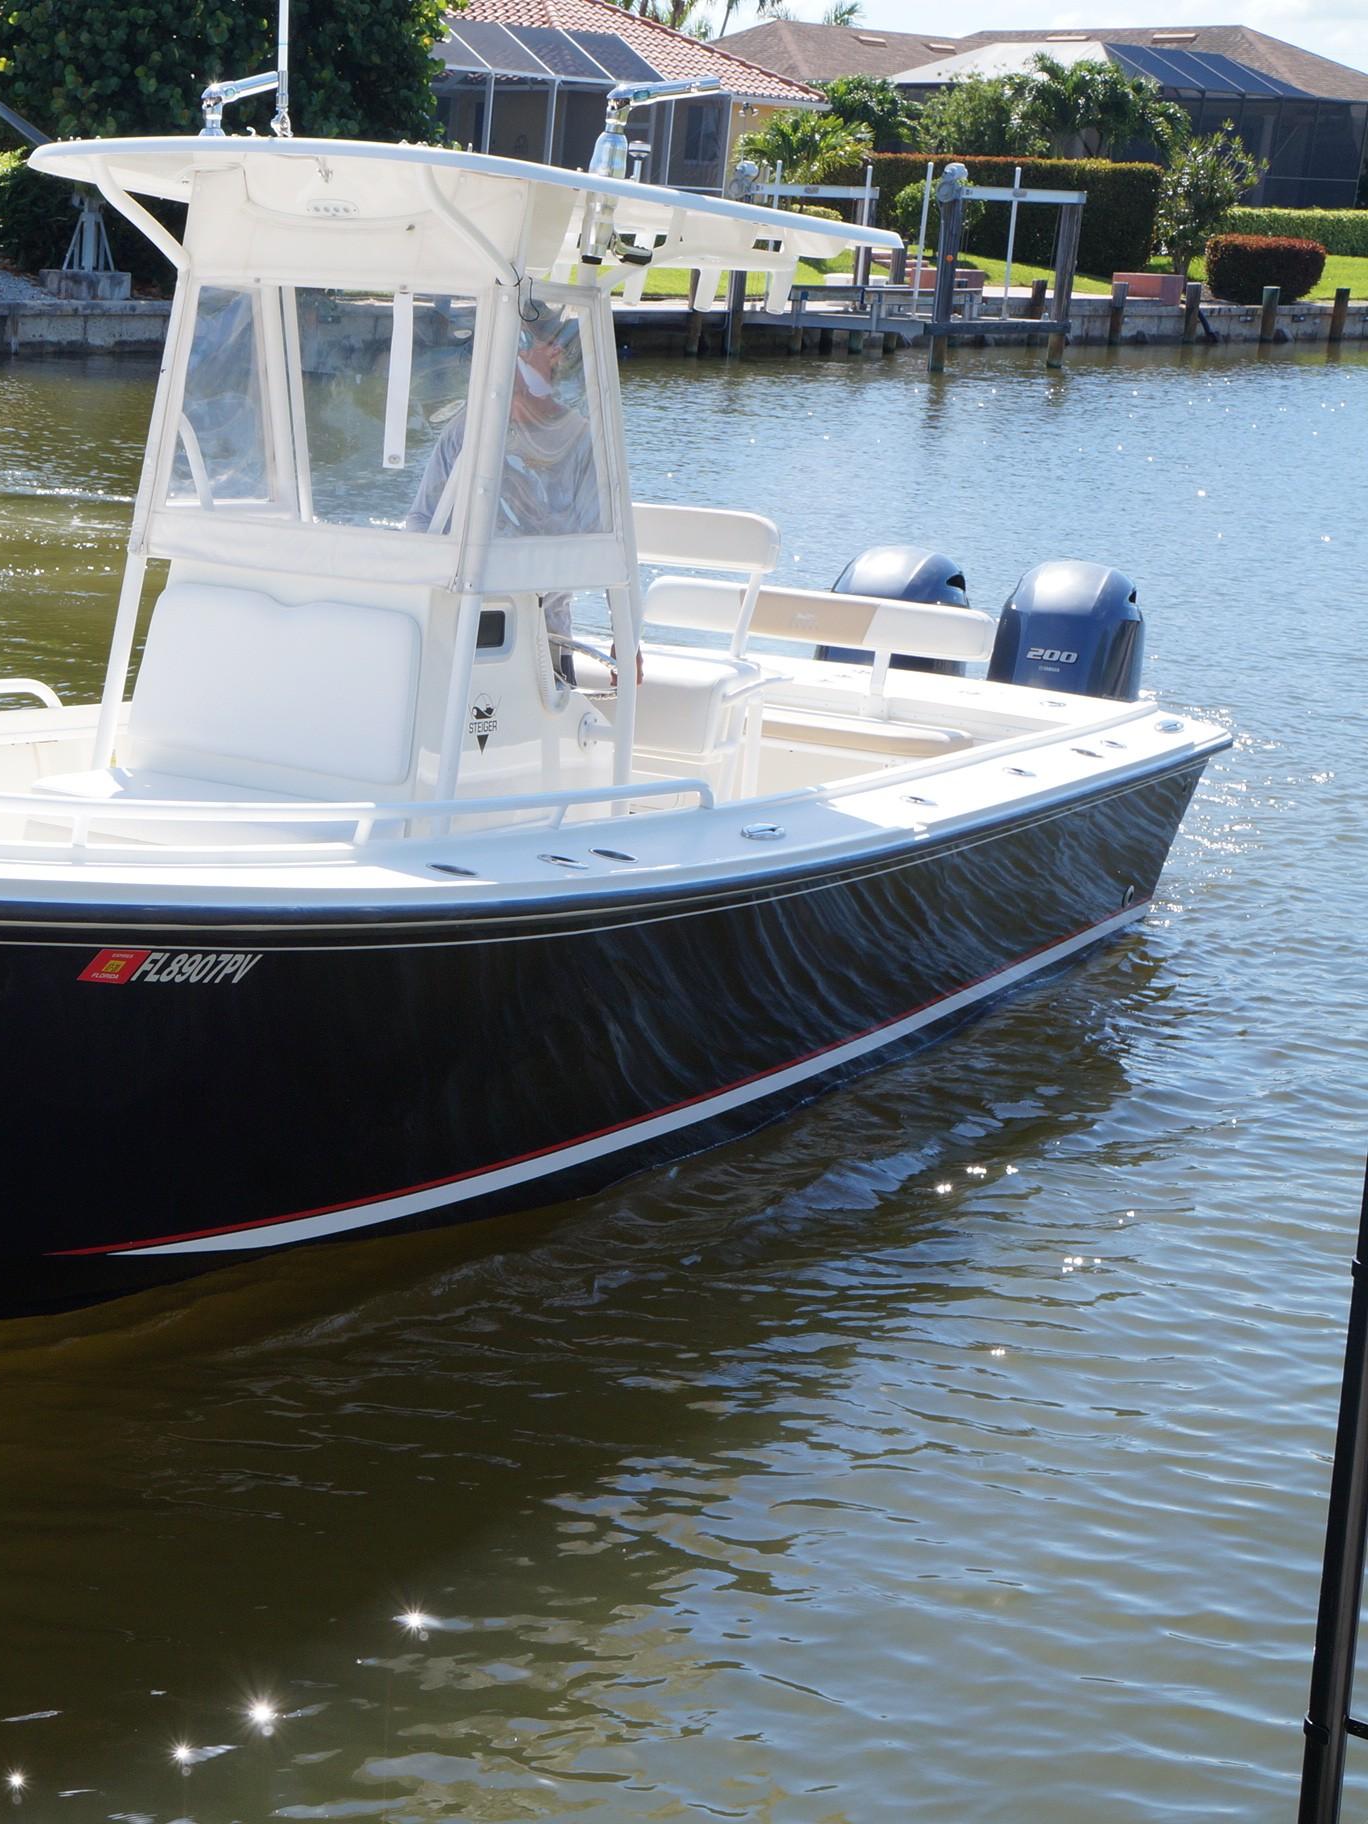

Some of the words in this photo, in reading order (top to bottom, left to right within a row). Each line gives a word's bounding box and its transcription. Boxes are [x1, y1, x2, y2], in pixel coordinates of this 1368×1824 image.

[1026, 647, 1078, 664] 200
[469, 720, 497, 734] STEIGER
[131, 952, 264, 984] FL8907PV
